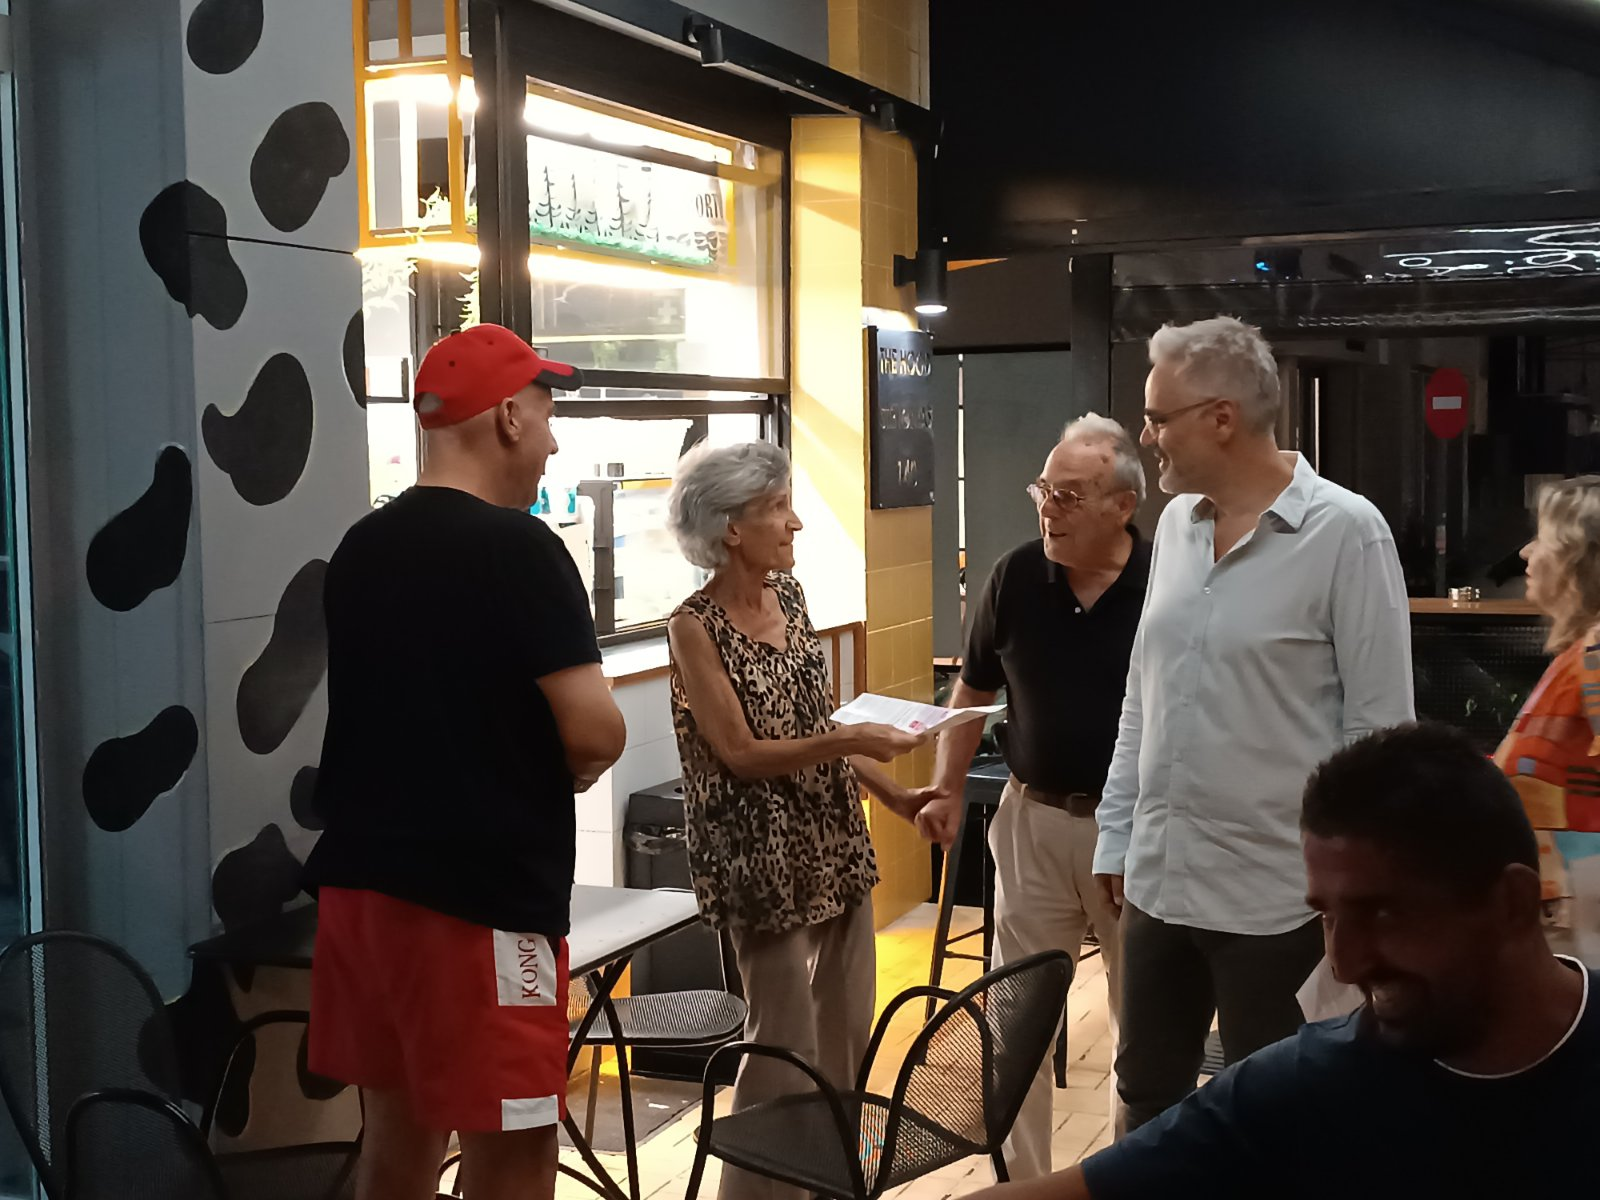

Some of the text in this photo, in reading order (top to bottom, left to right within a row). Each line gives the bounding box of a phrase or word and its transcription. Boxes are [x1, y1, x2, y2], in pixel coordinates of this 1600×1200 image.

[880, 347, 932, 376] THE HOOD
[518, 938, 541, 999] KONG
